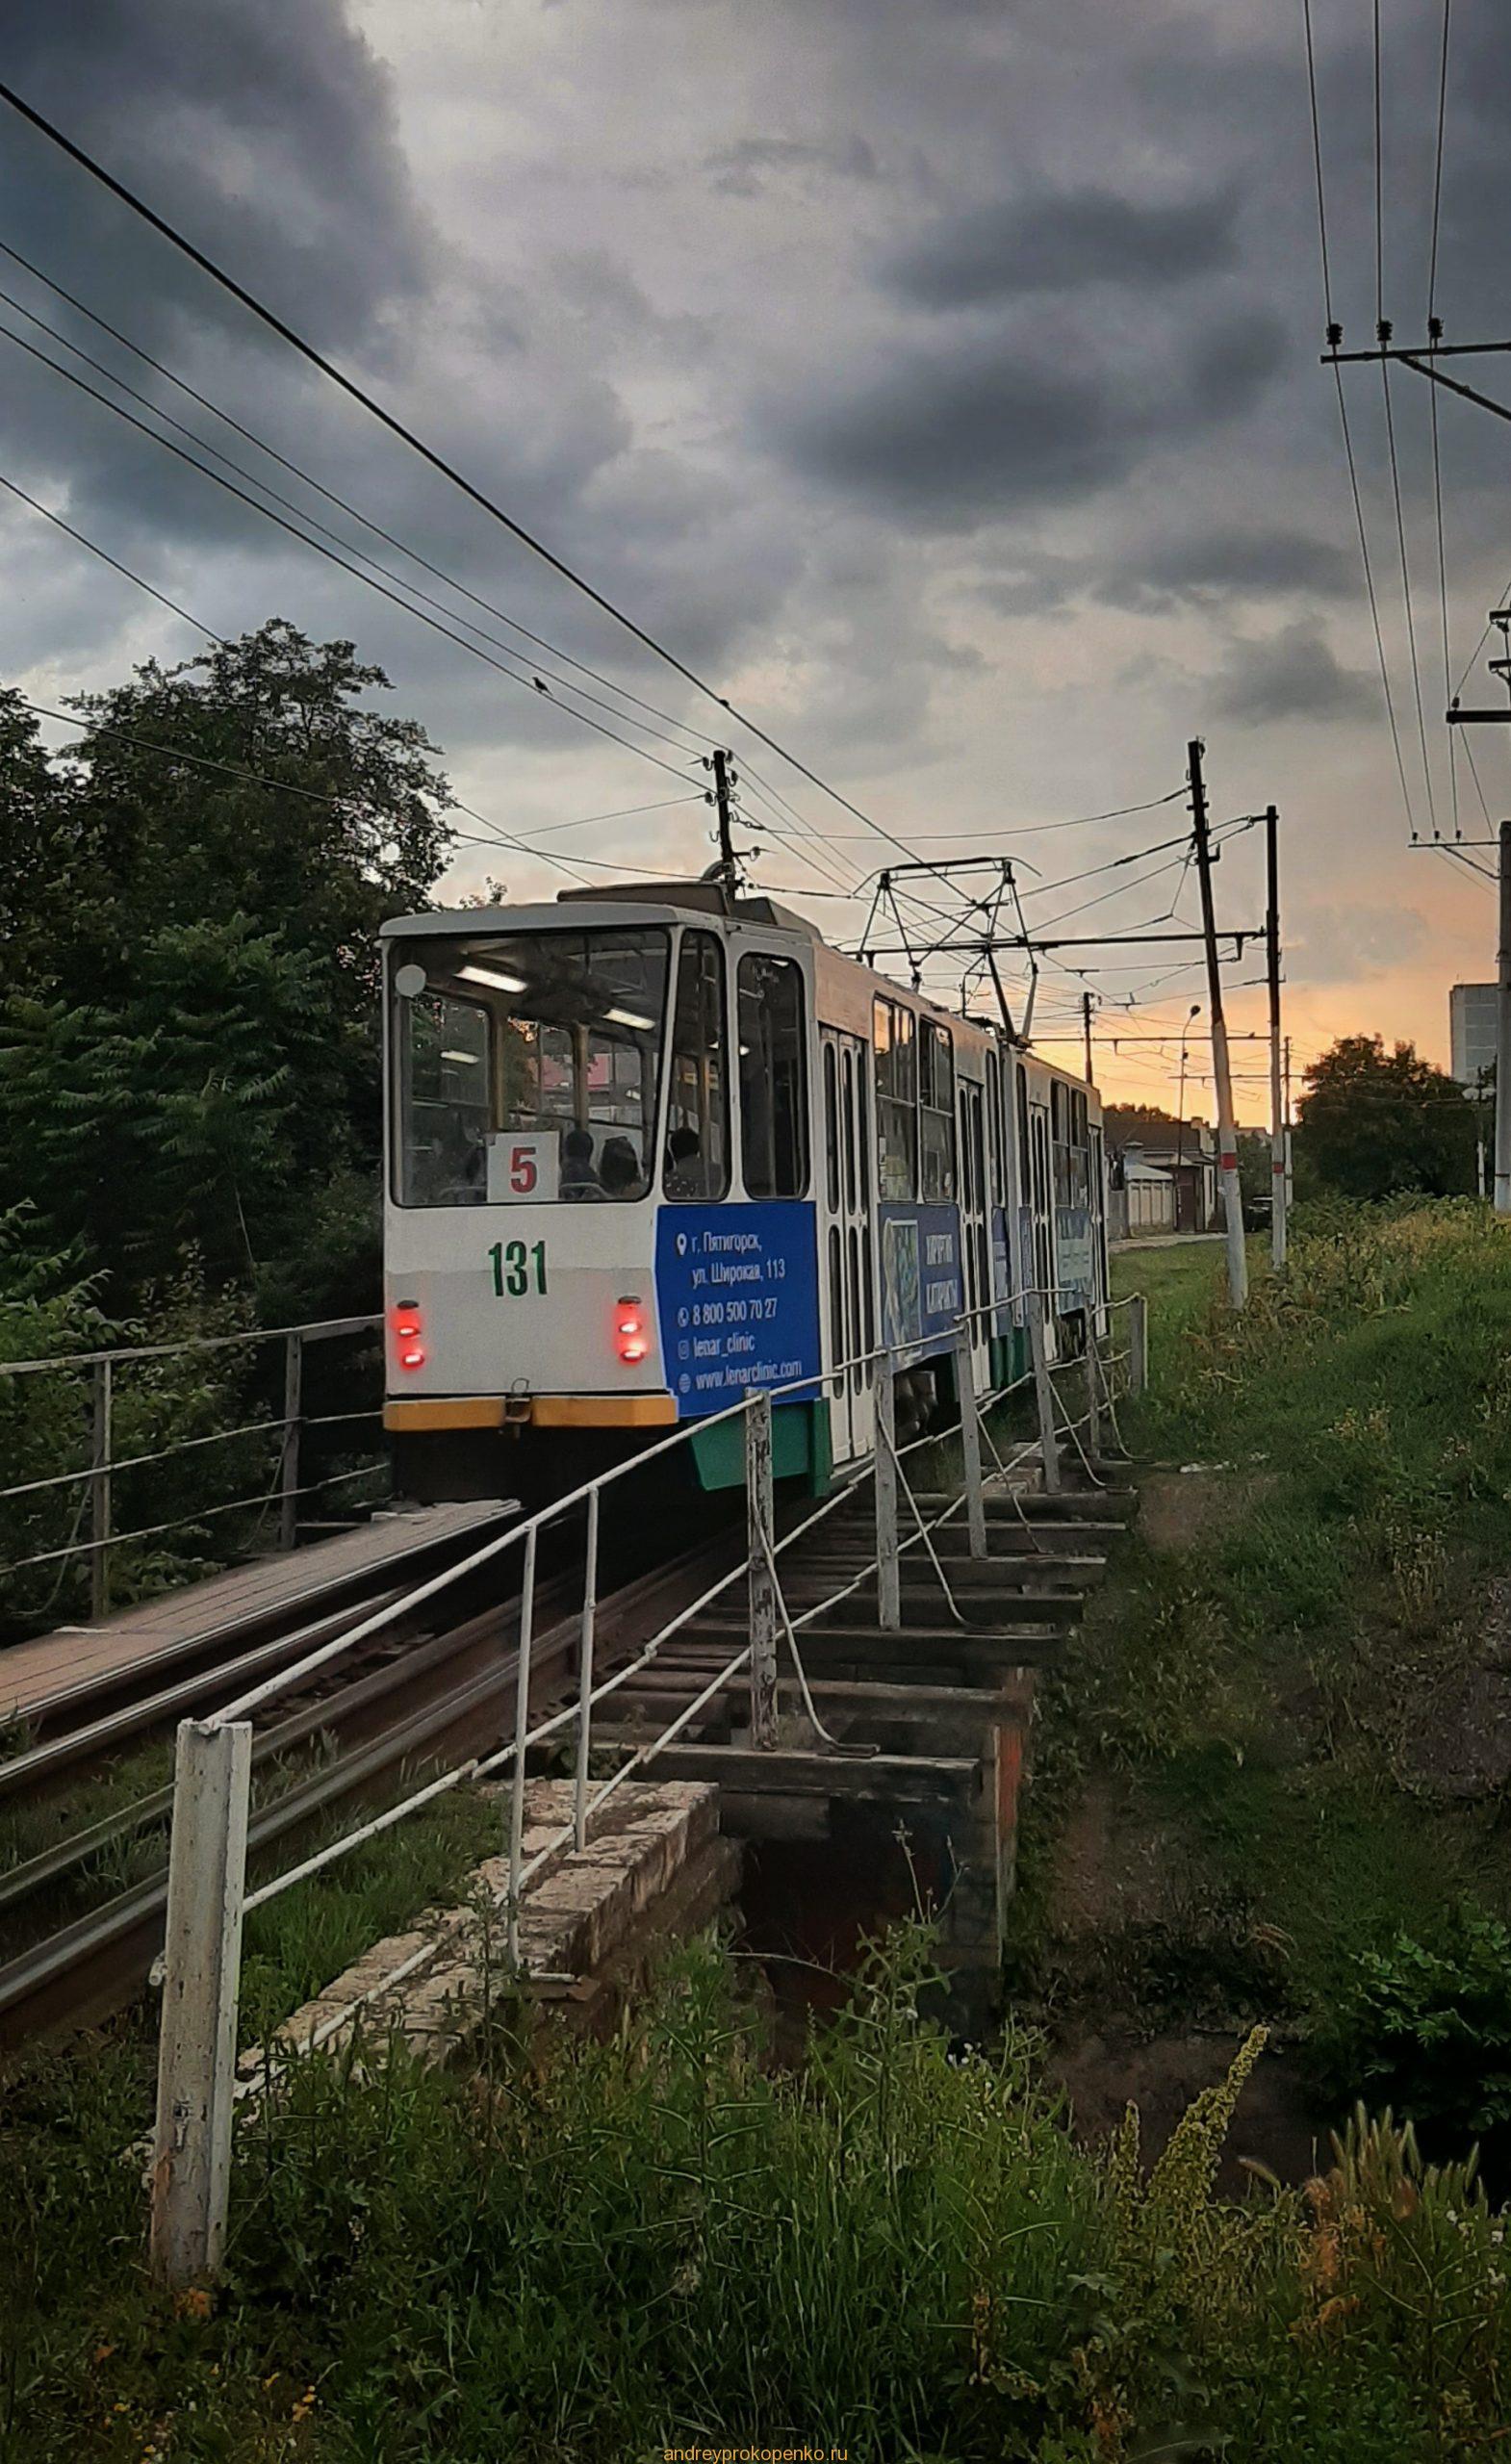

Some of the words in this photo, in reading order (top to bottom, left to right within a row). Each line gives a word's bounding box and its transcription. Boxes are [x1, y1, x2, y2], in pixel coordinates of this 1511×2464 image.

[509, 1146, 538, 1194] 5
[704, 1231, 762, 1254] Пятигорск,
[488, 1240, 548, 1297] 131
[710, 1262, 764, 1287] Широкая,
[766, 1258, 785, 1280] 113
[692, 1304, 701, 1325] 8
[702, 1302, 724, 1324] 800
[726, 1300, 747, 1322] 500
[749, 1298, 762, 1320] 70
[764, 1297, 778, 1319] 27
[693, 1331, 756, 1359] lenar_clinic
[695, 1360, 803, 1390] www.lenarclinic.com
